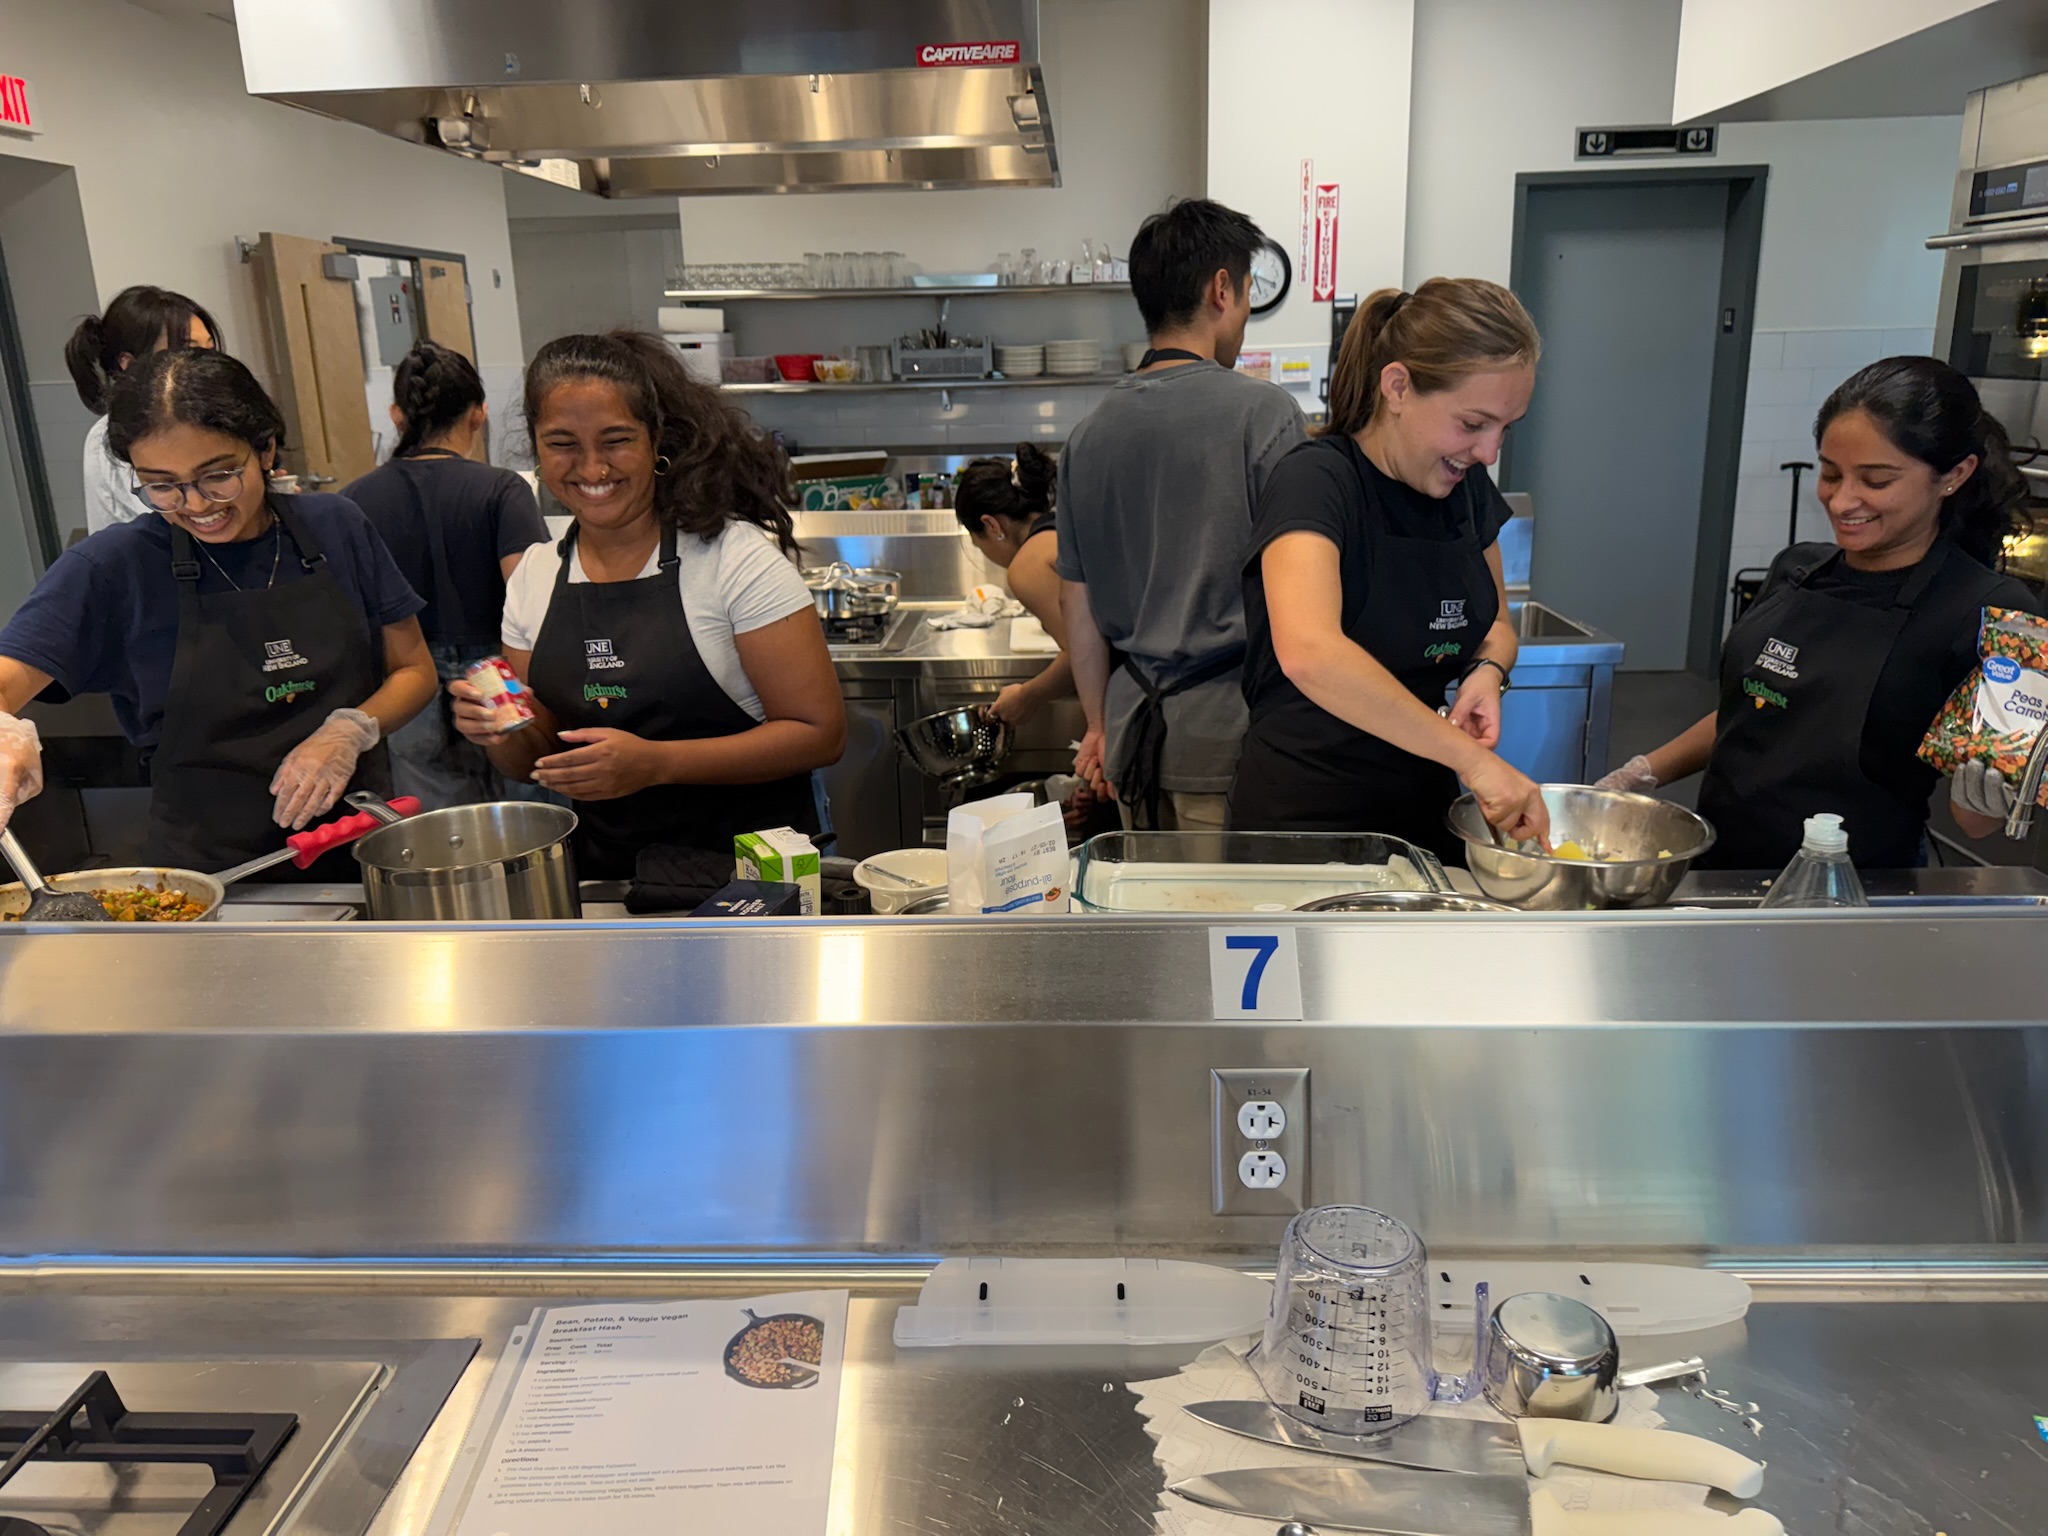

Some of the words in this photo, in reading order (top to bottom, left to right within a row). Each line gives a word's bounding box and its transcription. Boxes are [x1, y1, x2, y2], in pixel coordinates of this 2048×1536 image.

[921, 44, 1016, 62] CAPTIVEAIRE
[0, 75, 30, 126] XIT
[1318, 196, 1337, 209] FIRE
[1320, 210, 1330, 289] EXTINGUISHER
[1429, 622, 1446, 630] NEW
[268, 642, 291, 655] UNE
[1767, 641, 1794, 659] UNE
[589, 660, 625, 670] ENGLAND
[1986, 659, 2015, 674] Great
[1991, 669, 2013, 680] Value
[265, 680, 316, 703] Oakhurst
[583, 683, 628, 701] Oakhurst
[2011, 690, 2043, 708] Peas
[2004, 700, 2048, 721] Carrot
[1042, 846, 1056, 854] BEST
[999, 874, 1017, 887] flour
[1005, 873, 1053, 895] all-purpose
[1225, 936, 1279, 1010] 7
[1307, 1289, 1327, 1304] 100
[1380, 1294, 1387, 1303] 2
[556, 1318, 580, 1326] Bean,
[584, 1316, 616, 1324] Potato,
[628, 1314, 658, 1323] Veggie
[660, 1313, 688, 1321] Vegan
[1380, 1310, 1387, 1318] 4
[1304, 1313, 1326, 1329] 200
[1379, 1323, 1386, 1332] 6
[552, 1326, 596, 1334] Breakfast
[1302, 1334, 1323, 1350] 300
[1379, 1337, 1386, 1346] 8
[1377, 1350, 1390, 1359] 10
[1299, 1353, 1321, 1370] 400
[1377, 1362, 1390, 1371] 12
[1296, 1373, 1319, 1390] 500
[1376, 1375, 1390, 1384] 14
[1376, 1386, 1390, 1395] 16
[1304, 1398, 1320, 1412] ml
[1366, 1413, 1378, 1421] OZ
[1380, 1411, 1391, 1420] US
[500, 1456, 540, 1464] Directions
